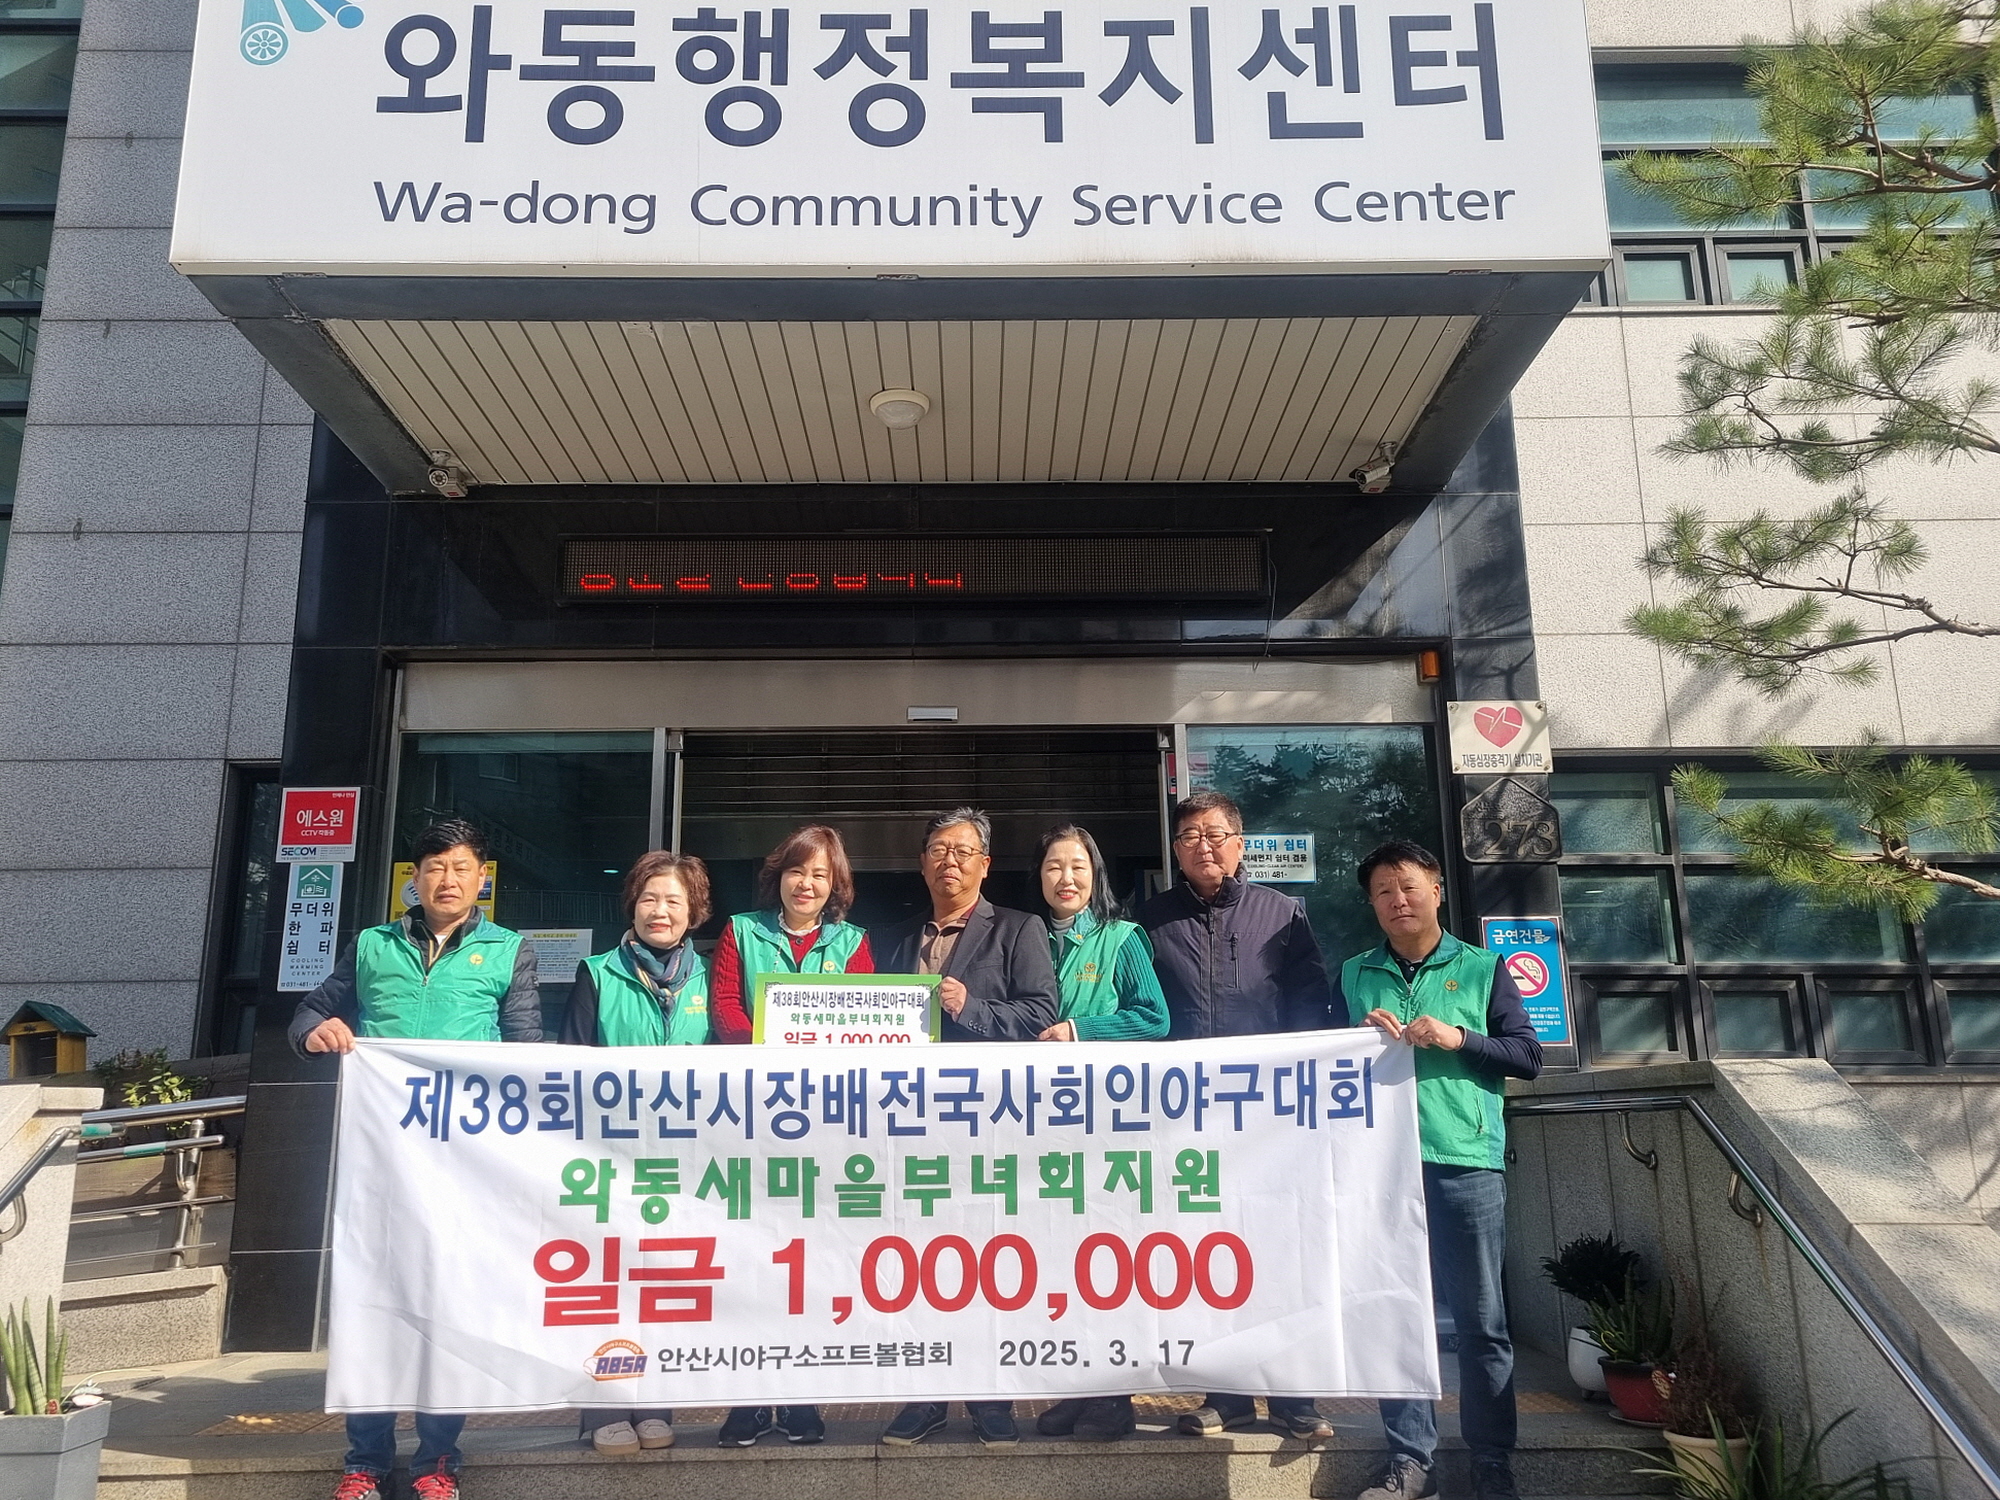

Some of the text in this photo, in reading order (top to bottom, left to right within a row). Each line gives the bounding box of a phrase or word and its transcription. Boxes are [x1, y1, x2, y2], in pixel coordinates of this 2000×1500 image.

[376, 3, 1504, 148] 와동행정복지센터
[373, 180, 1516, 238] Wa-dong Community Service Center
[1462, 752, 1543, 769] 자동심장충격기 설치기관
[296, 809, 344, 827] 에스원
[1284, 838, 1307, 851] 쉼터
[1484, 820, 1558, 856] 273
[281, 846, 317, 856] SECOM
[1275, 853, 1290, 862] 쉼터
[1491, 929, 1546, 945] 금연건물
[772, 990, 925, 1009] 제38회안산시장배전국사회인야구대회
[790, 1013, 905, 1026] 와동새마을부녀회지원
[399, 1056, 1375, 1143] 제38회안산시장배전국사회인야구대회
[559, 1148, 1222, 1225] 와동새마을부녀회지원
[532, 1231, 1254, 1328] 일금 1,000,000
[595, 1355, 648, 1375] ABSA
[657, 1338, 1195, 1373] 안산시야구소프트볼협회 2025. 3. 17
